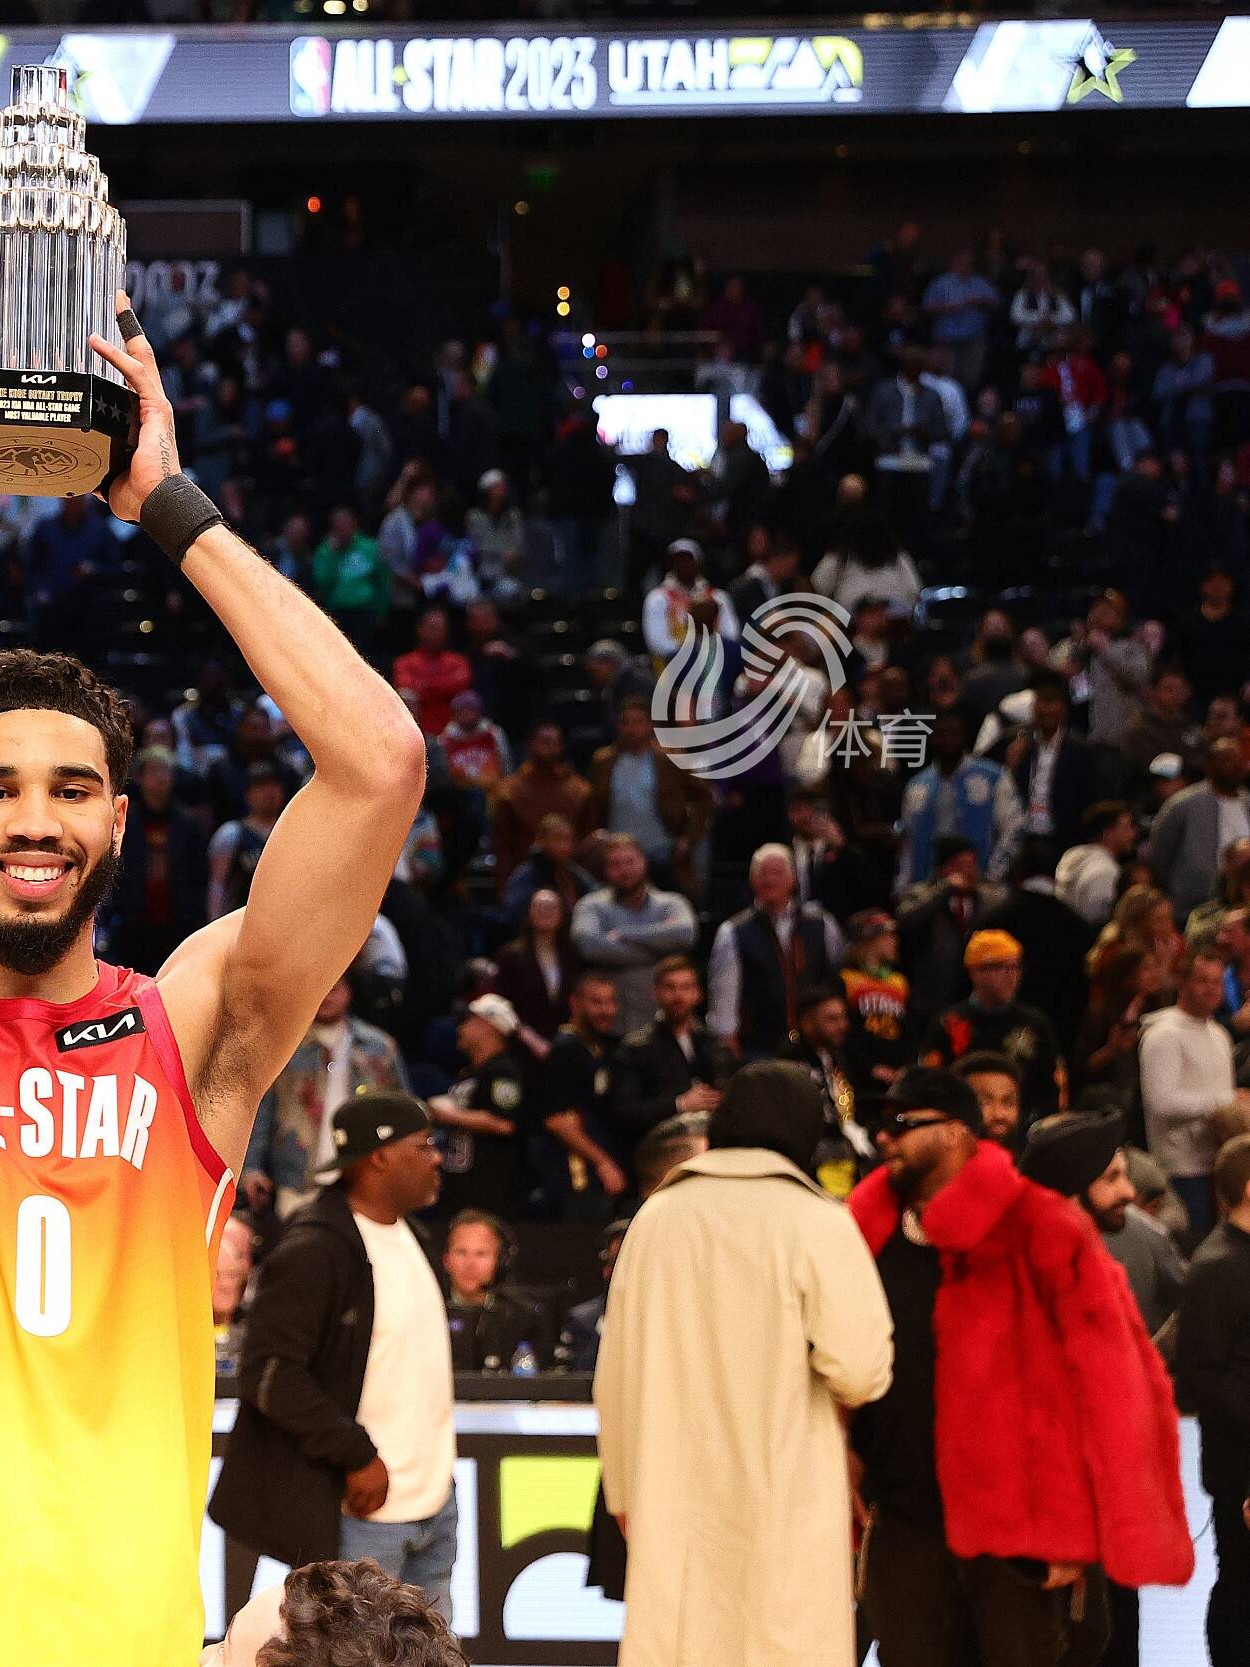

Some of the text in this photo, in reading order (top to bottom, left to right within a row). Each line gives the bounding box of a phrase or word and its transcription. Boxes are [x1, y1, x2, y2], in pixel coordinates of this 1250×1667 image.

[503, 36, 598, 112] 2023
[608, 38, 729, 93] UTAH
[4, 410, 21, 420] MOST
[50, 412, 72, 423] PLAYER
[63, 403, 81, 413] GAME
[15, 1195, 72, 1337] 0
